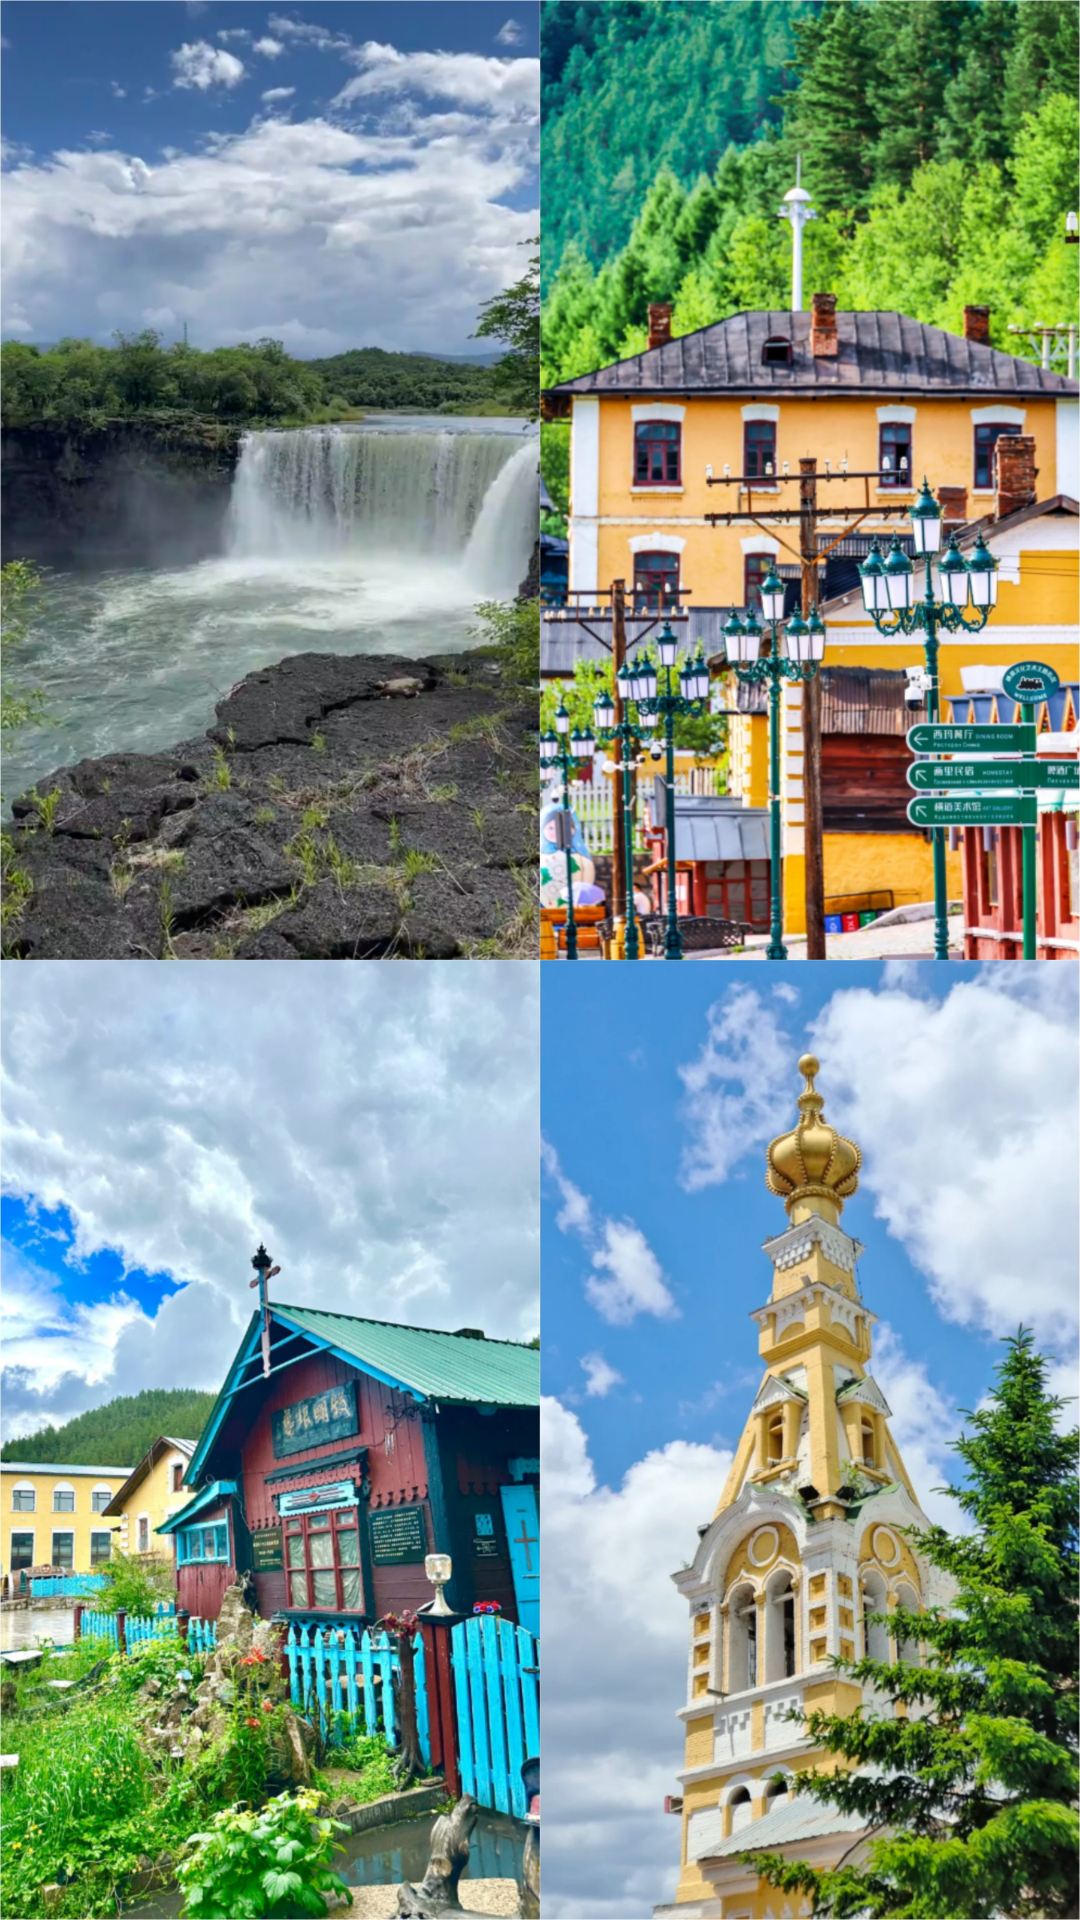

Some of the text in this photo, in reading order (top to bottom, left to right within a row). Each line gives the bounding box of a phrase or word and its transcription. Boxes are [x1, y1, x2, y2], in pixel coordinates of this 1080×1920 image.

[933, 729, 974, 740] 西玛餐厅
[934, 802, 981, 812] 横道美术馆
